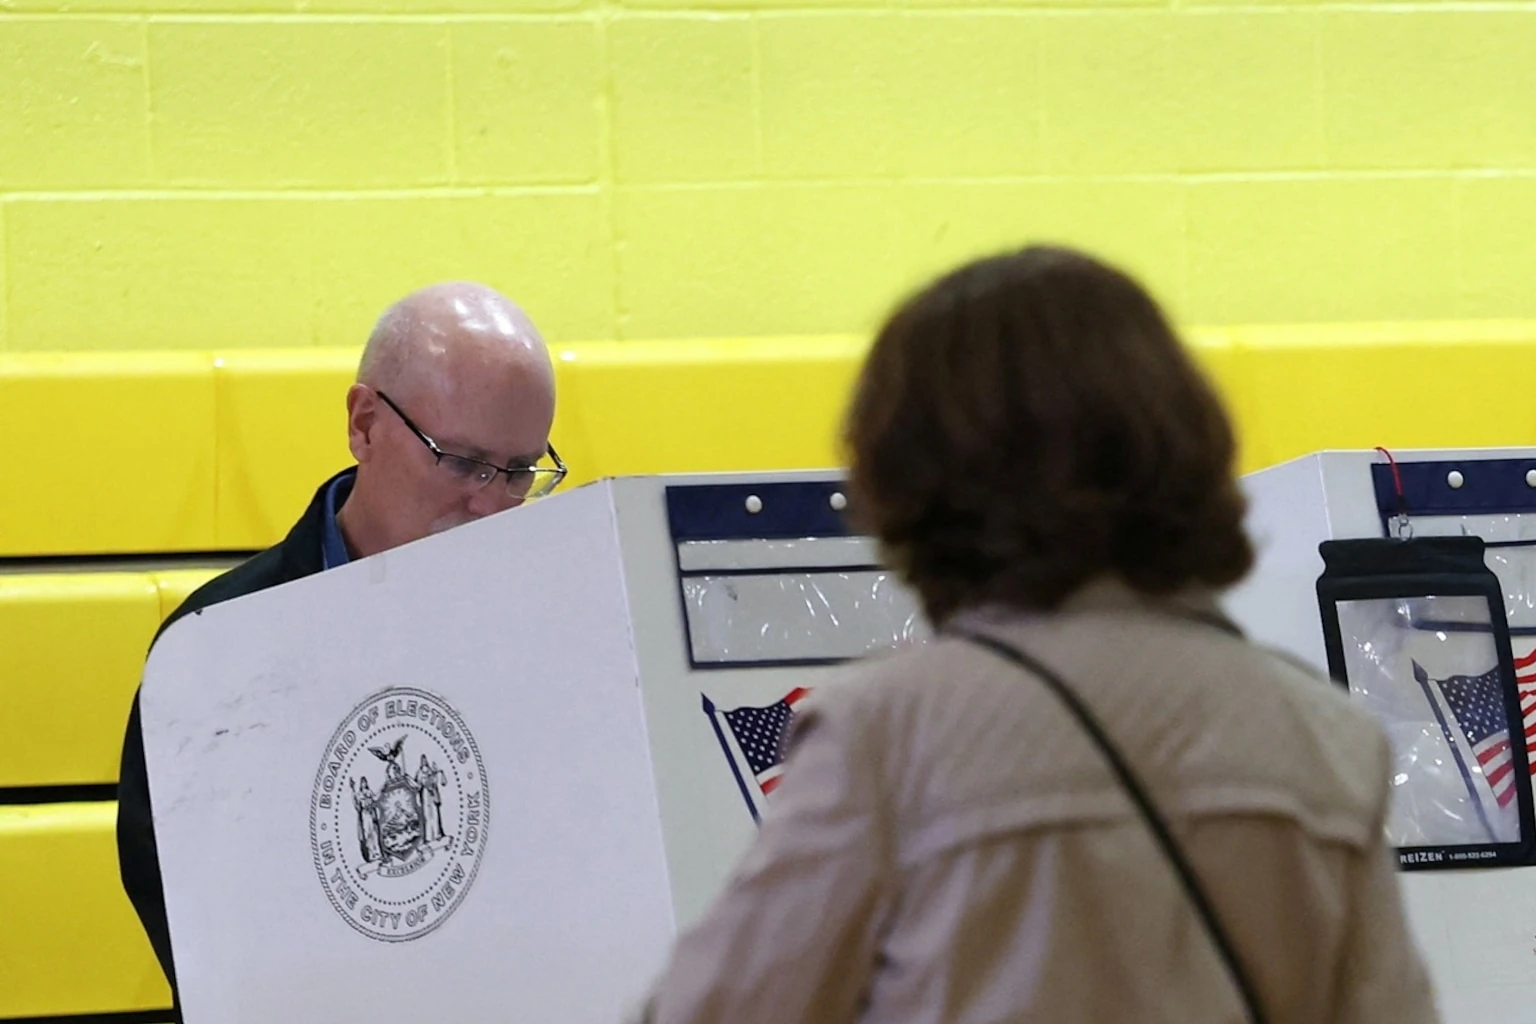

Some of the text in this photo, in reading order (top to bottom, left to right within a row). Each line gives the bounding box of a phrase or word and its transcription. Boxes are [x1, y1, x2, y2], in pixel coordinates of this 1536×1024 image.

[319, 699, 470, 810] BOARD OF ELECTIONS
[320, 791, 480, 929] IN THE CITY OF NEW YORK
